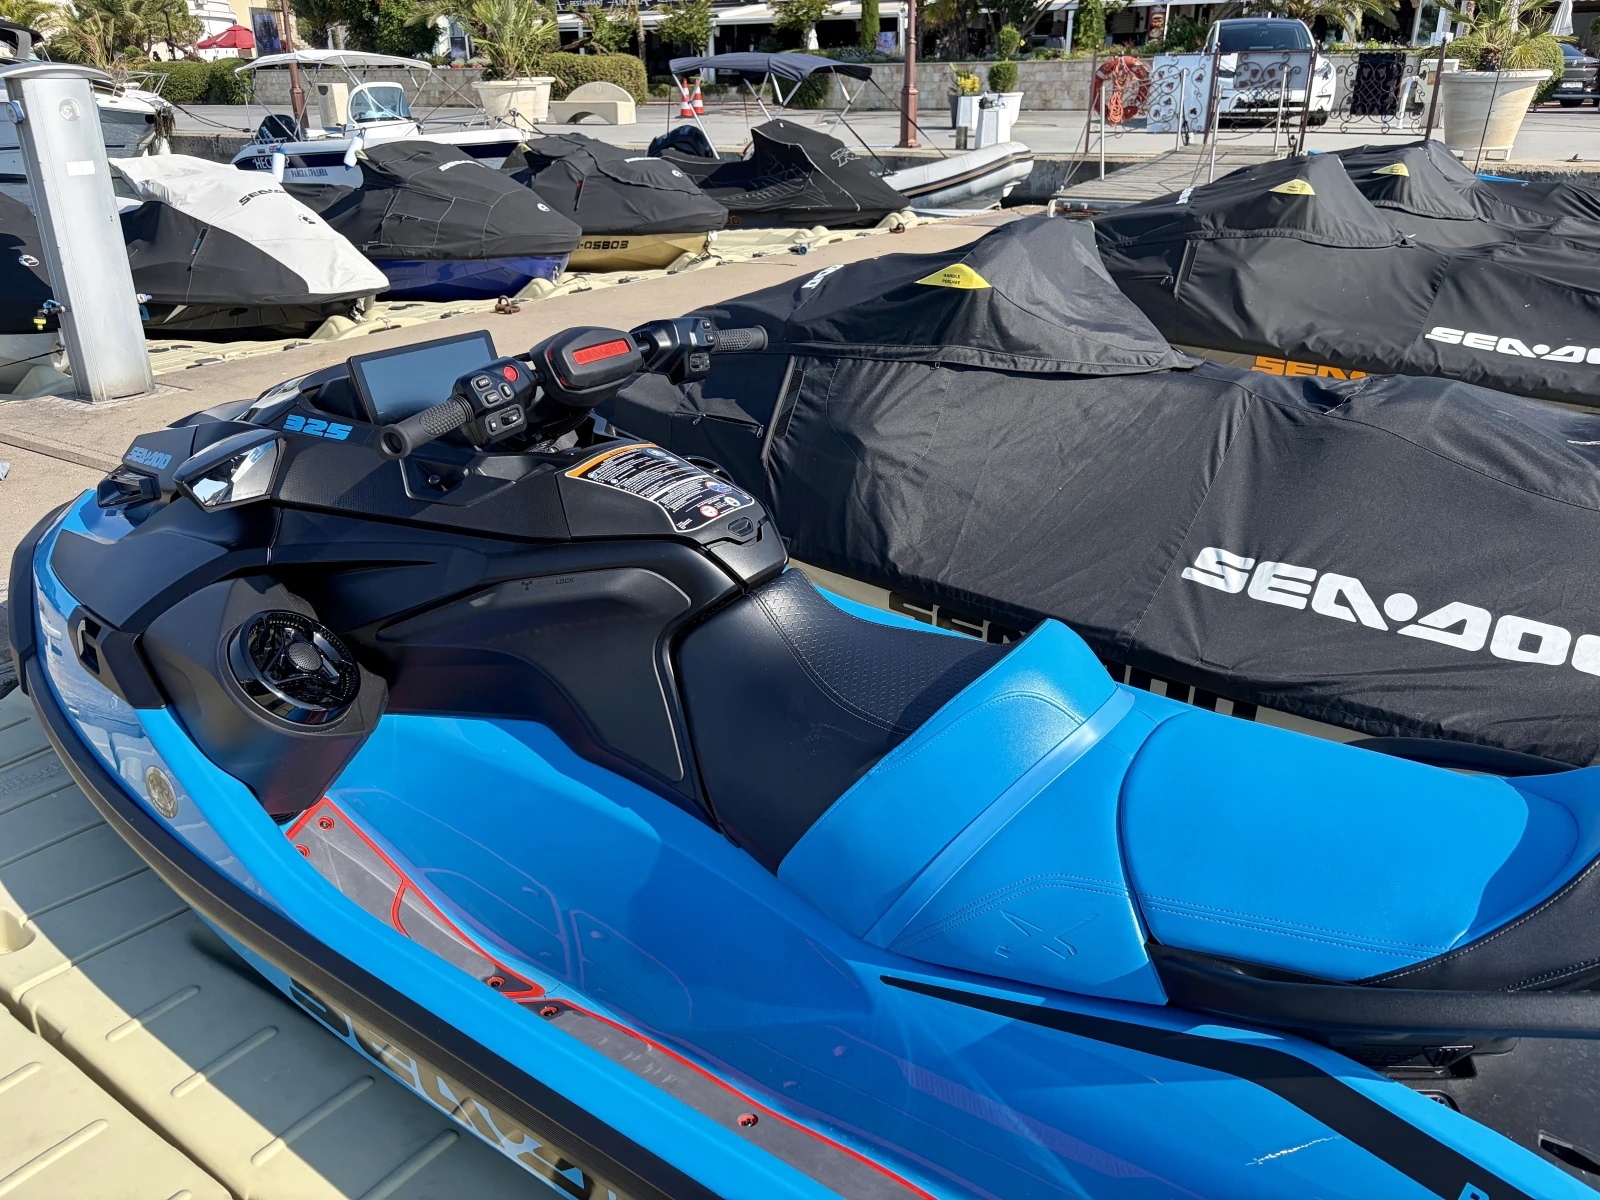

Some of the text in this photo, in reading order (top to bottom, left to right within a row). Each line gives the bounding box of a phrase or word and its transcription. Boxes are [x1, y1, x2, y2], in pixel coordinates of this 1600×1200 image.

[576, 240, 629, 250] -05803
[283, 414, 353, 441] 325
[555, 577, 575, 585] LOCK
